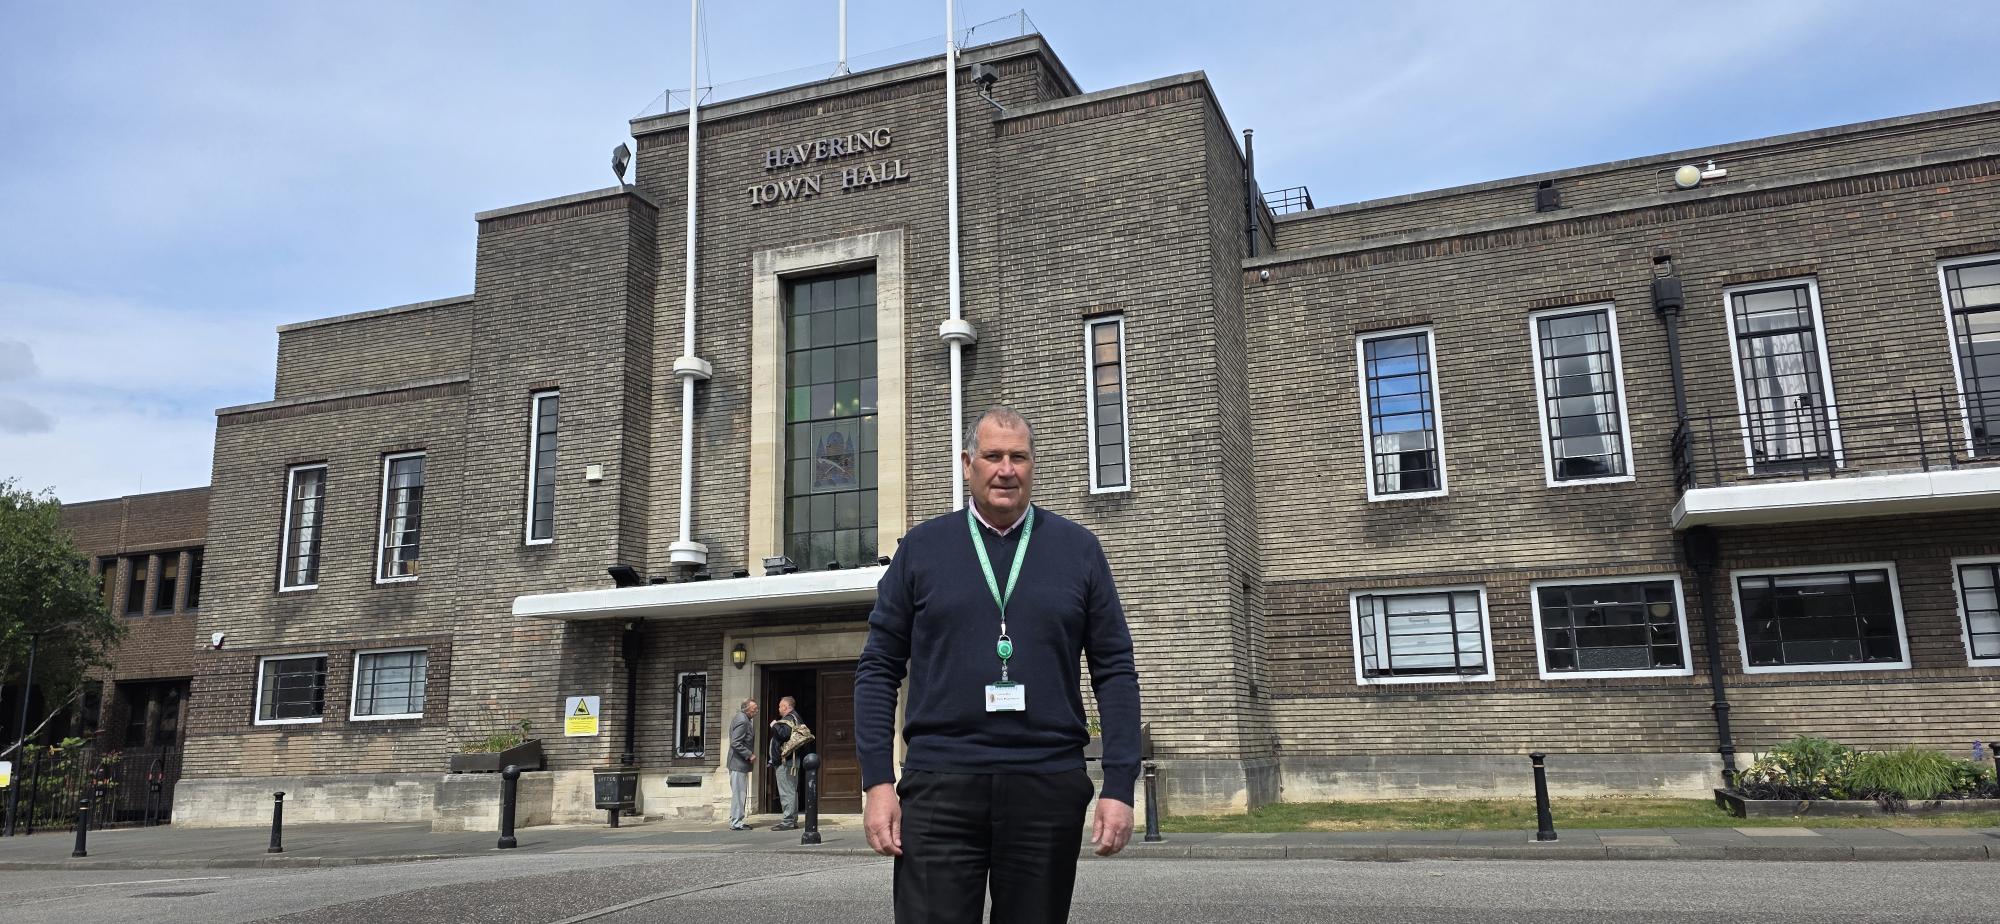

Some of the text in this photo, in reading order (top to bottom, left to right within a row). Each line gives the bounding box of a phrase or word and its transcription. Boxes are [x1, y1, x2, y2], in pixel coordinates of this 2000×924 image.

[764, 127, 892, 169] HAVERING
[747, 159, 909, 205] TOWN HALL
